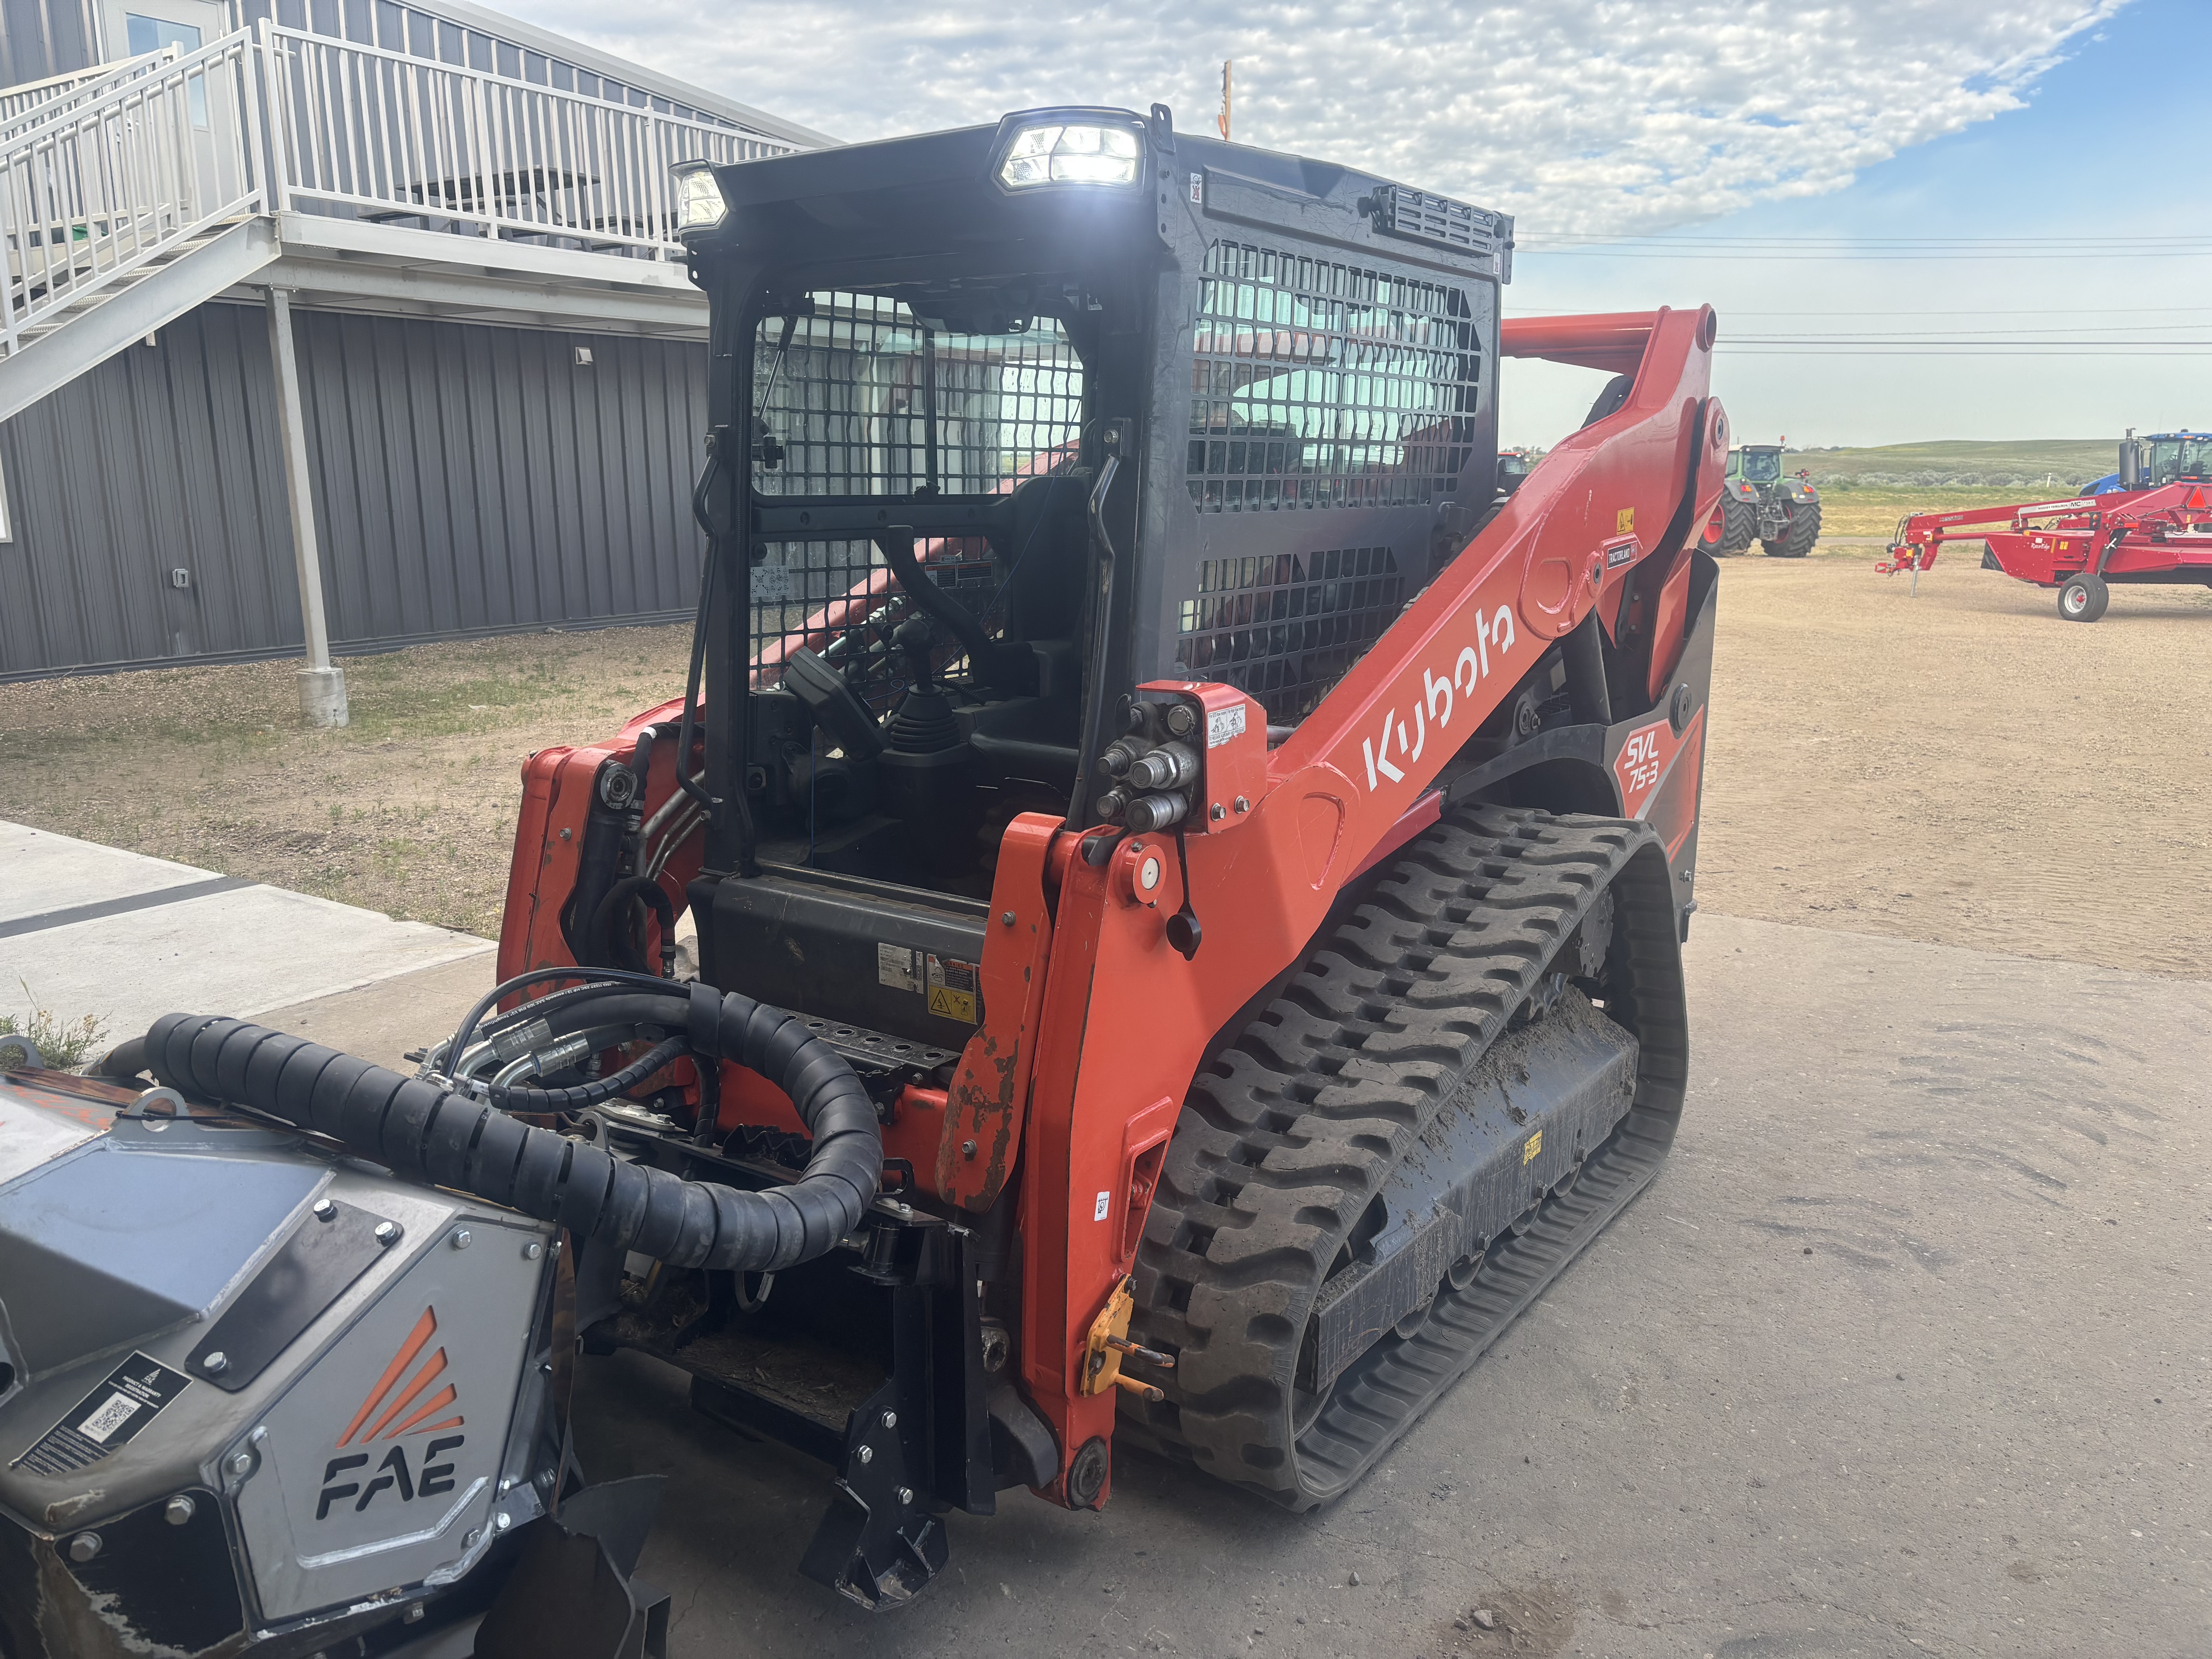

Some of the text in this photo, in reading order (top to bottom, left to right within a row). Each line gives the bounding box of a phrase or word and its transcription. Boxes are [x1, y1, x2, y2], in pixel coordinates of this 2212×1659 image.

[1609, 548, 1630, 563] TRACTORLAND
[1362, 605, 1515, 792] Kubota
[1624, 731, 1659, 769] SVL
[1628, 760, 1659, 793] 75-3
[480, 1014, 510, 1029] ToughGuard
[122, 1376, 140, 1386] PRODUCT
[141, 1386, 161, 1398] WARRANTY
[125, 1383, 150, 1398] REGISTRATION
[315, 1434, 465, 1521] FAE
